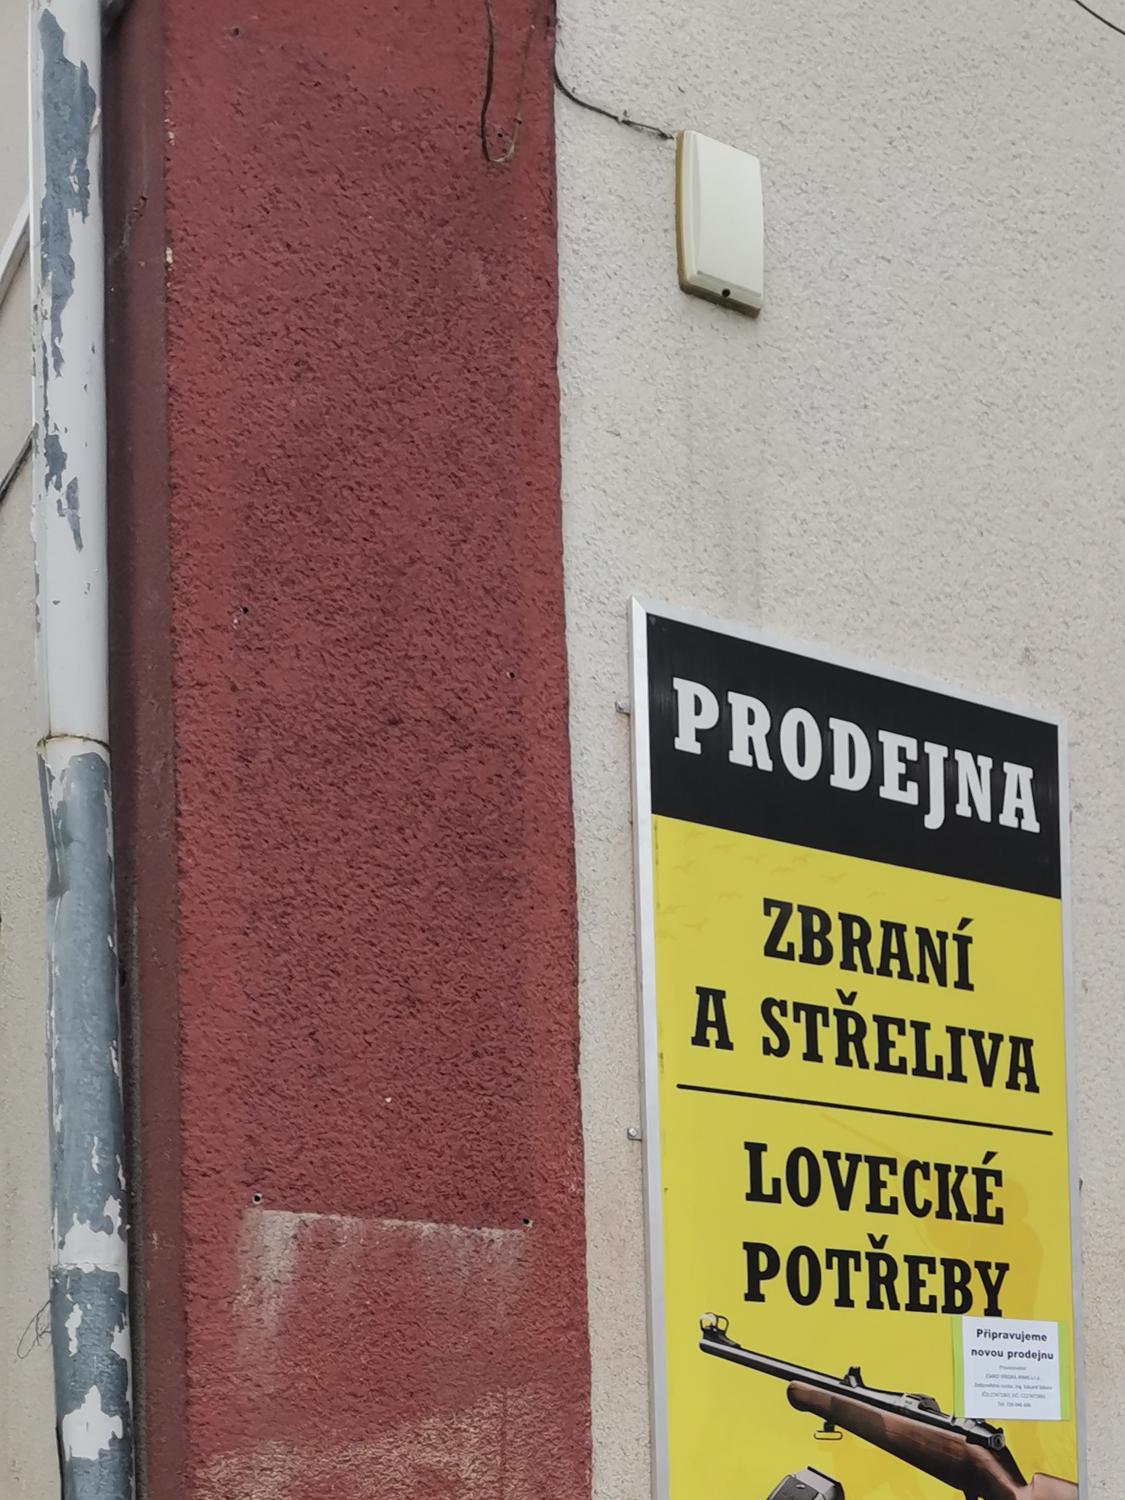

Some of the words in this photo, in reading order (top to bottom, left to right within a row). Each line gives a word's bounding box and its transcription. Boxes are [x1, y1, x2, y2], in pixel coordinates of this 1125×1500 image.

[673, 677, 1040, 833] PRODEJNA
[763, 897, 975, 992] ZBRANÍ
[691, 986, 734, 1051] A
[760, 988, 1040, 1094] STŘELIVA
[743, 1141, 1004, 1225] LOVECKÉ
[743, 1233, 1010, 1317] POTŘEBY
[971, 1348, 1004, 1358] novou
[1007, 1348, 1054, 1361] prodejnu
[976, 1328, 1048, 1343] Připravujeme
